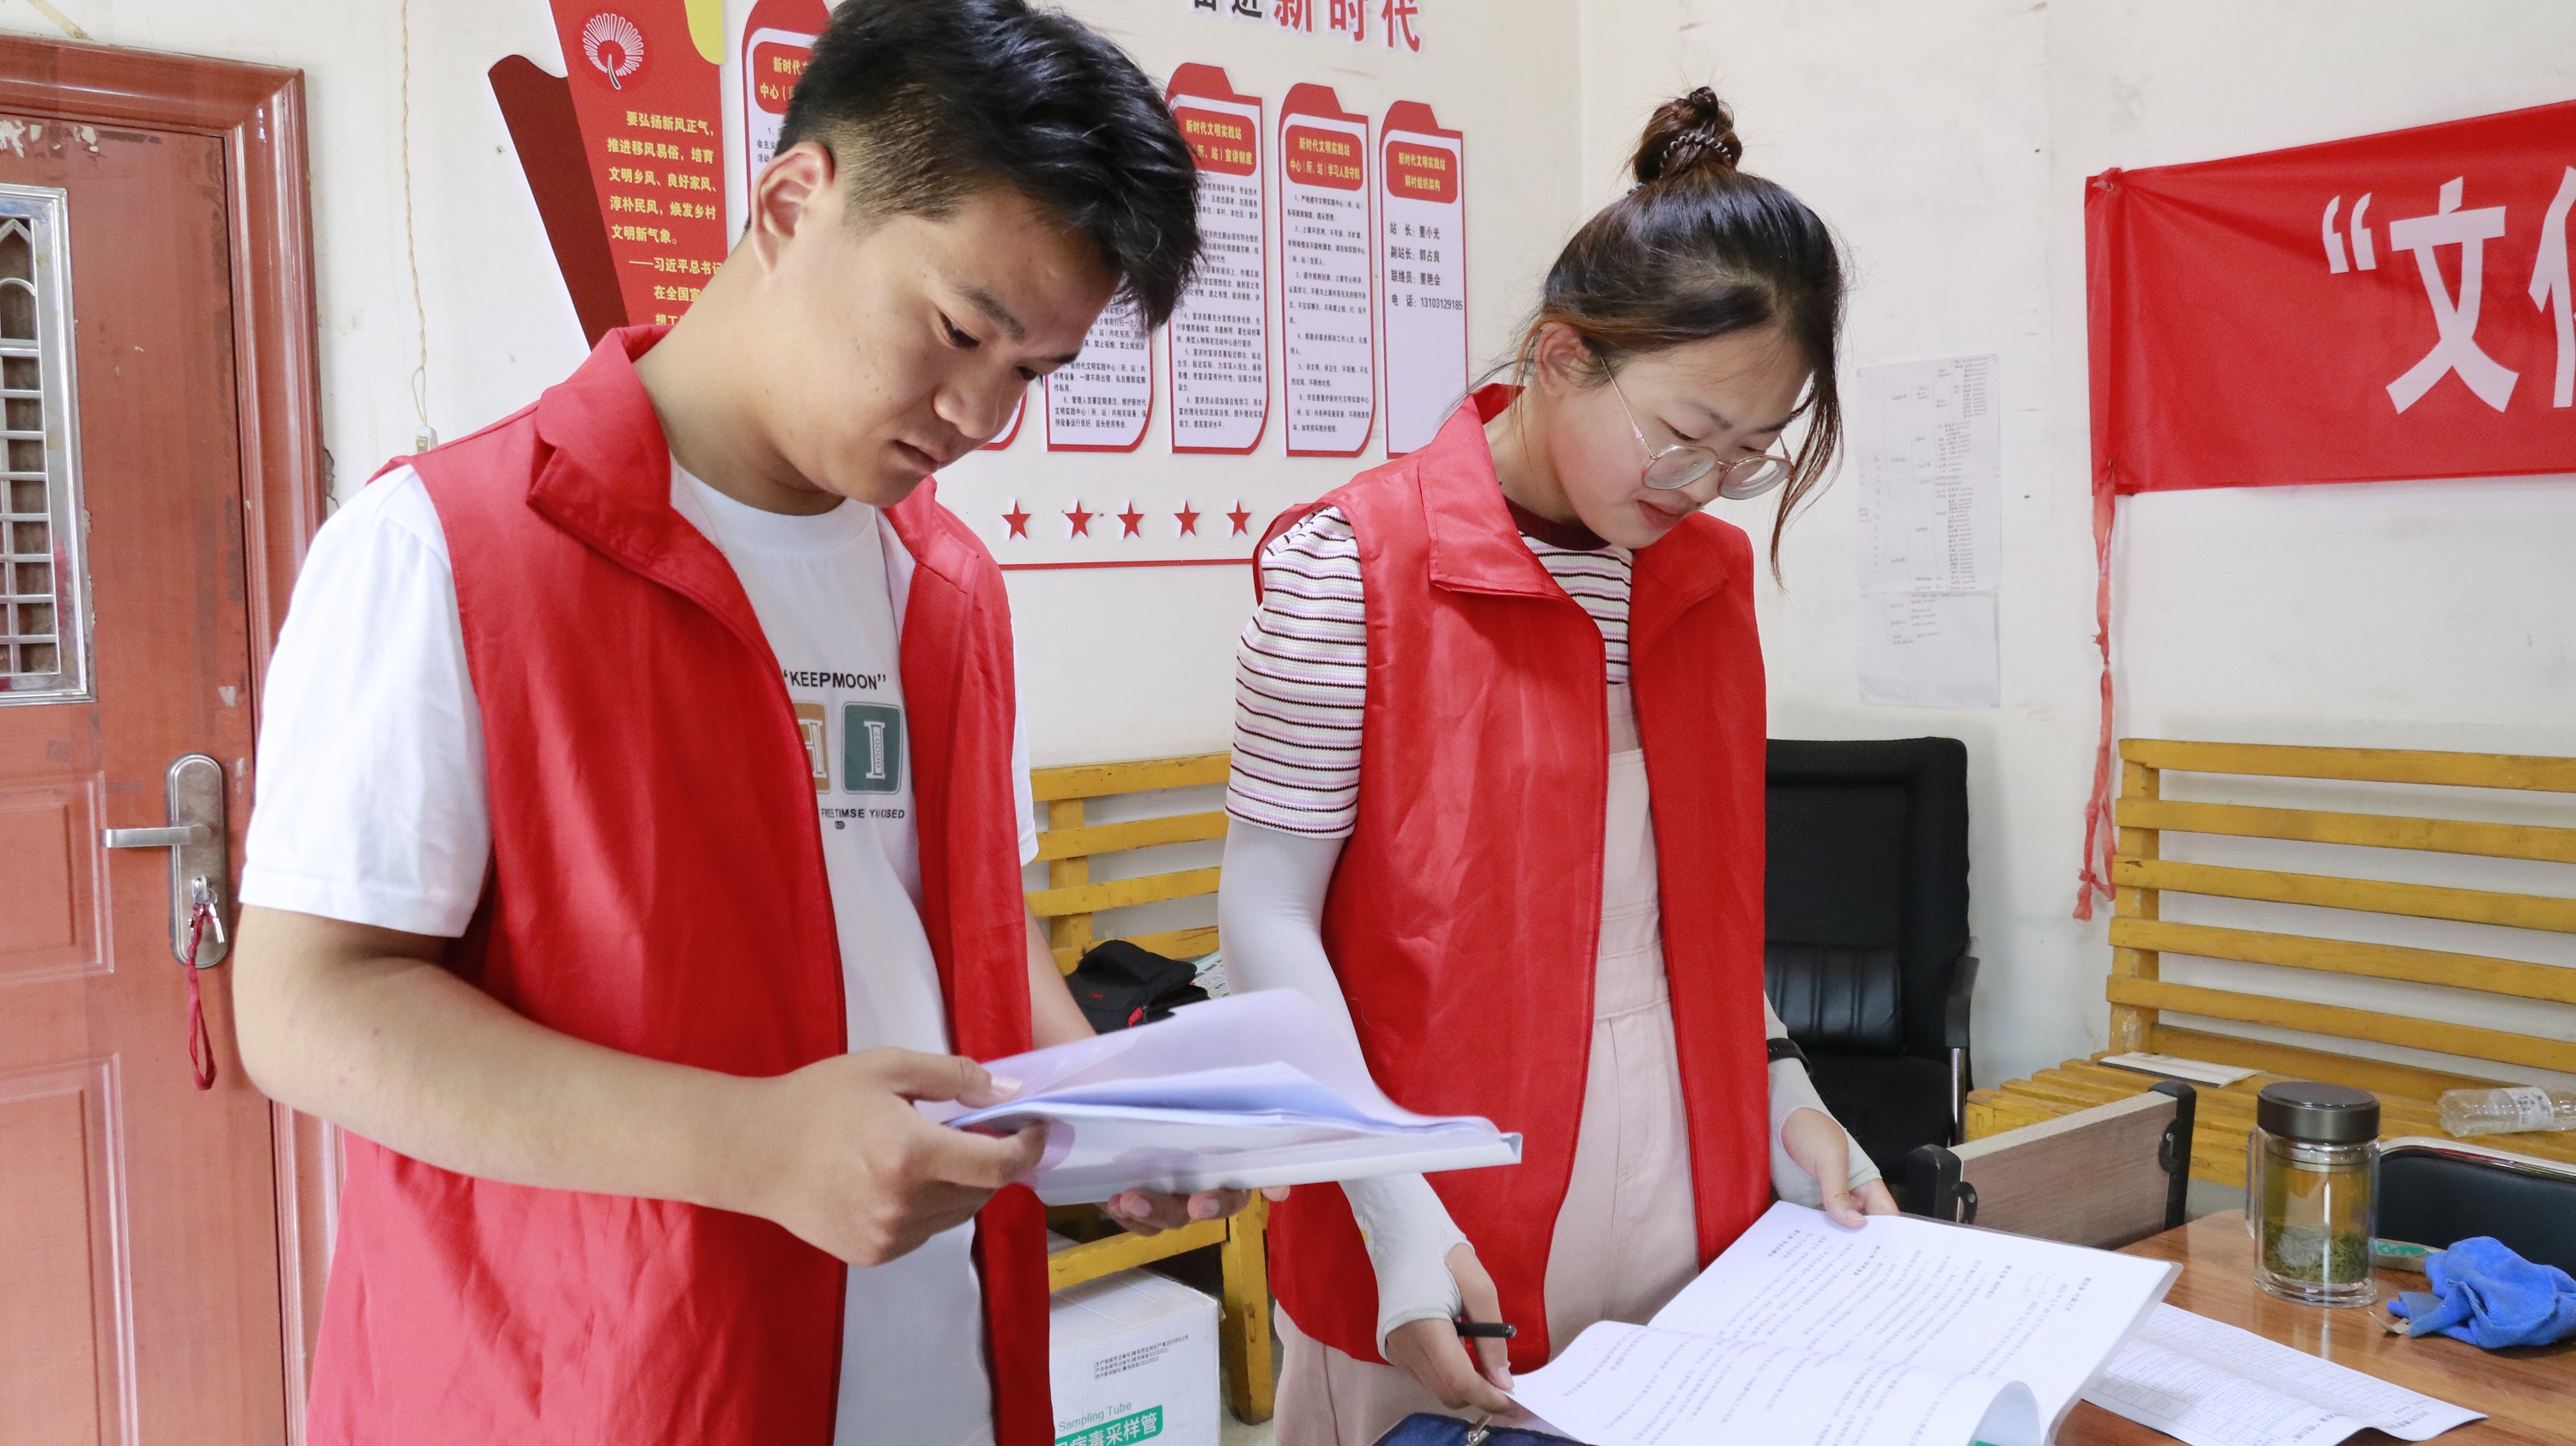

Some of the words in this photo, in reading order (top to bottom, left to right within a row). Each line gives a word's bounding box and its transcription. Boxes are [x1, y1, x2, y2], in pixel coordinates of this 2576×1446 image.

[626, 111, 714, 136] 要弘扬新风正气，
[1186, 118, 1242, 141] 新时代文明实践站
[607, 138, 714, 163] 推进移风易俗，培育
[1299, 137, 1350, 157] 新时代文明实践站
[1399, 152, 1446, 172] 新时代文明实践站
[609, 167, 716, 192] 文明乡风、良好家风、
[611, 224, 677, 245] 文明新气象。
[1059, 1410, 1104, 1432] Sampling
[1107, 1401, 1132, 1417] Tube
